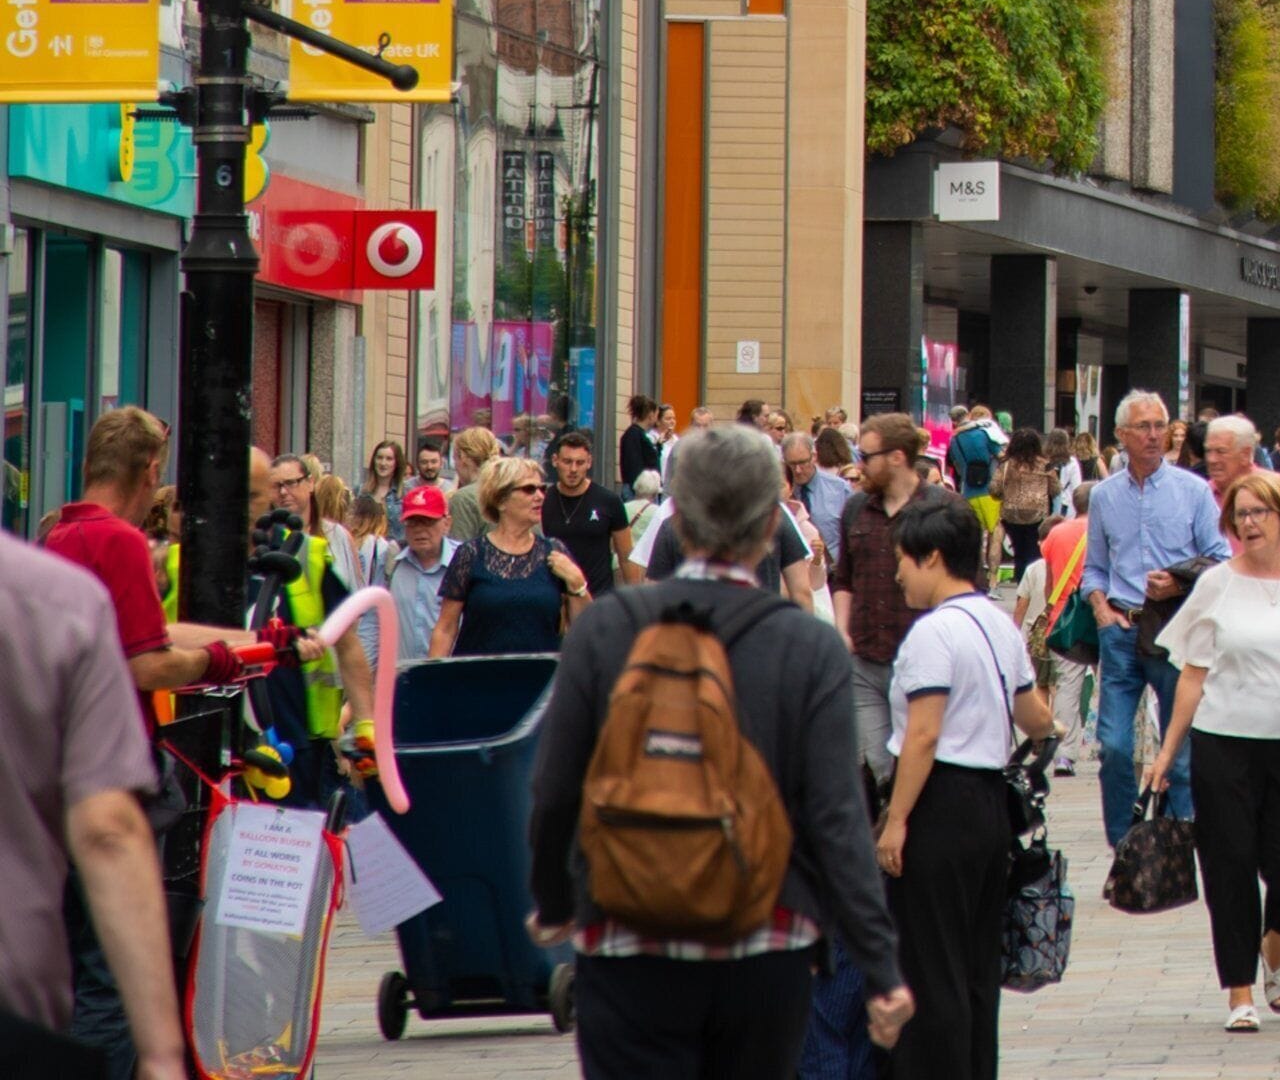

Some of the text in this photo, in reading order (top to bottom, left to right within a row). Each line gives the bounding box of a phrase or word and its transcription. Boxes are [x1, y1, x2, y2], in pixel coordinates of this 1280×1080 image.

[417, 43, 440, 58] UK
[949, 180, 986, 196] M&S
[254, 849, 268, 857] ALL
[270, 851, 301, 862] WORKS
[253, 860, 299, 873] DONATION
[230, 873, 304, 890] COINS IN THE POT
